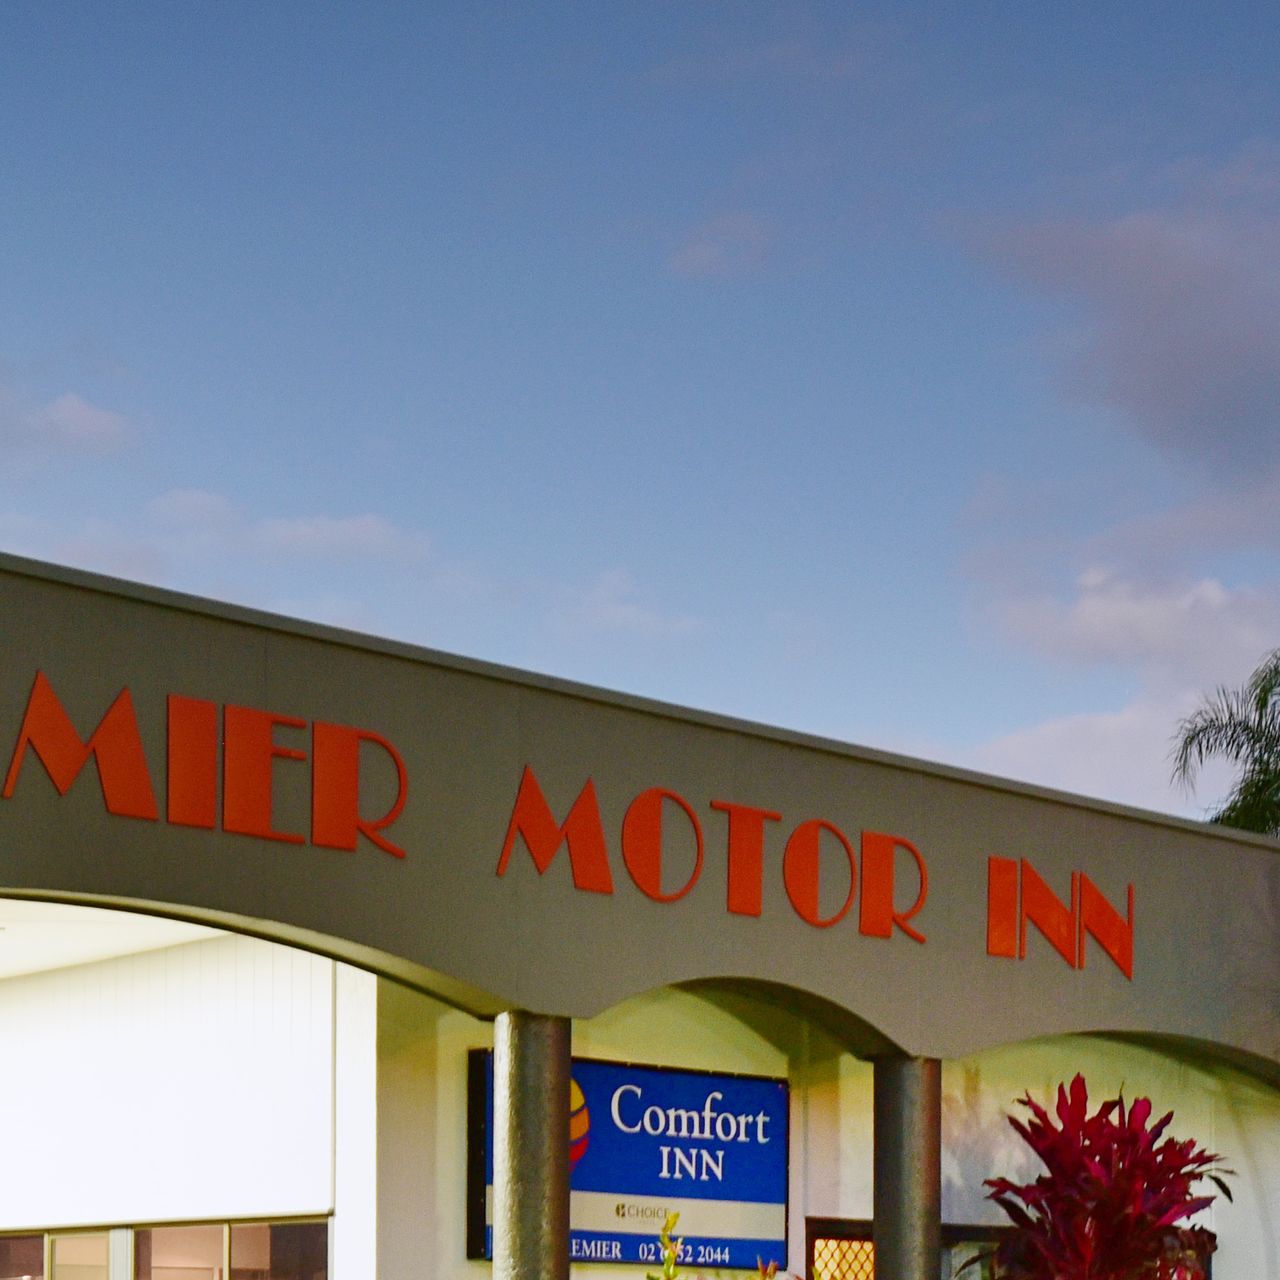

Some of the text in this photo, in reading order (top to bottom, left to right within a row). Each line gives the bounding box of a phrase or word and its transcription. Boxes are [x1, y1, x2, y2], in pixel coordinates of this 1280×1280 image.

[496, 763, 929, 945] MOTOR
[986, 854, 1135, 982] INN
[611, 1084, 770, 1143] Comfort
[658, 1146, 725, 1182] INN
[570, 1239, 621, 1259] EMIER
[638, 1242, 656, 1261] 02
[697, 1245, 730, 1264] 2044
